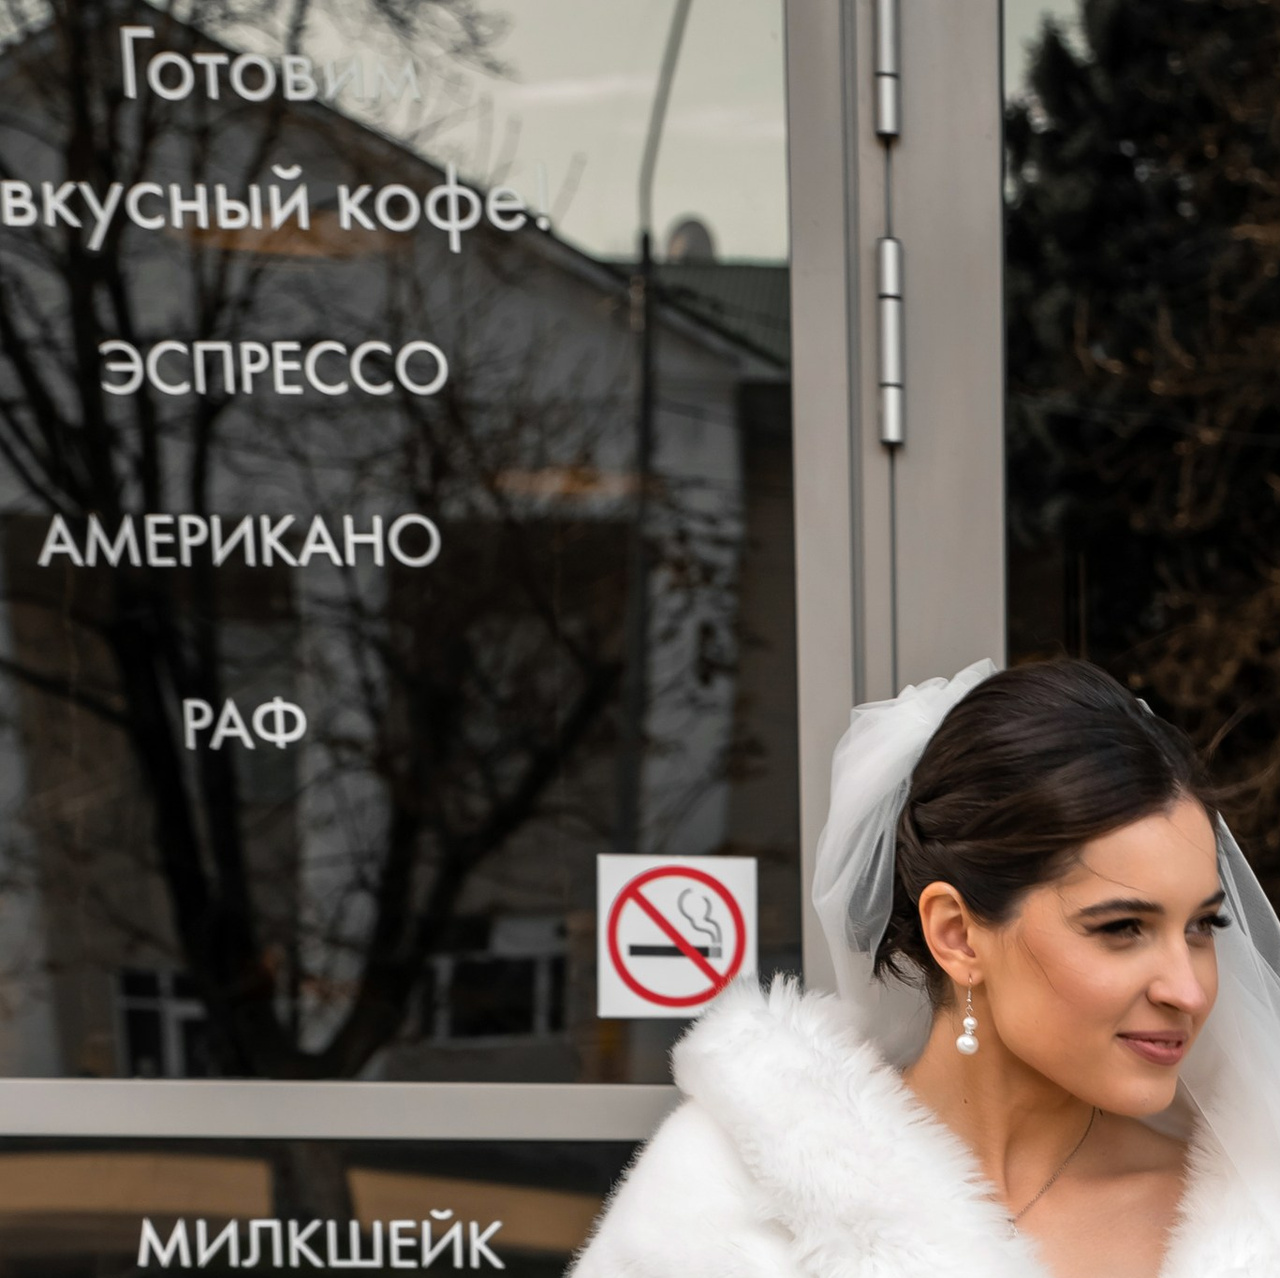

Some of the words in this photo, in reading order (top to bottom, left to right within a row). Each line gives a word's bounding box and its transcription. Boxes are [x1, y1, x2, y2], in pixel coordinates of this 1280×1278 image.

[119, 26, 421, 101] Готовим
[0, 164, 311, 251] вкусный
[339, 161, 551, 253] кофе!
[100, 340, 448, 395] ЭСПРЕССО
[38, 514, 441, 568] АМЕРИКАНО
[183, 697, 307, 749] РАФ
[136, 1208, 506, 1270] МИЛКШЕЙК
